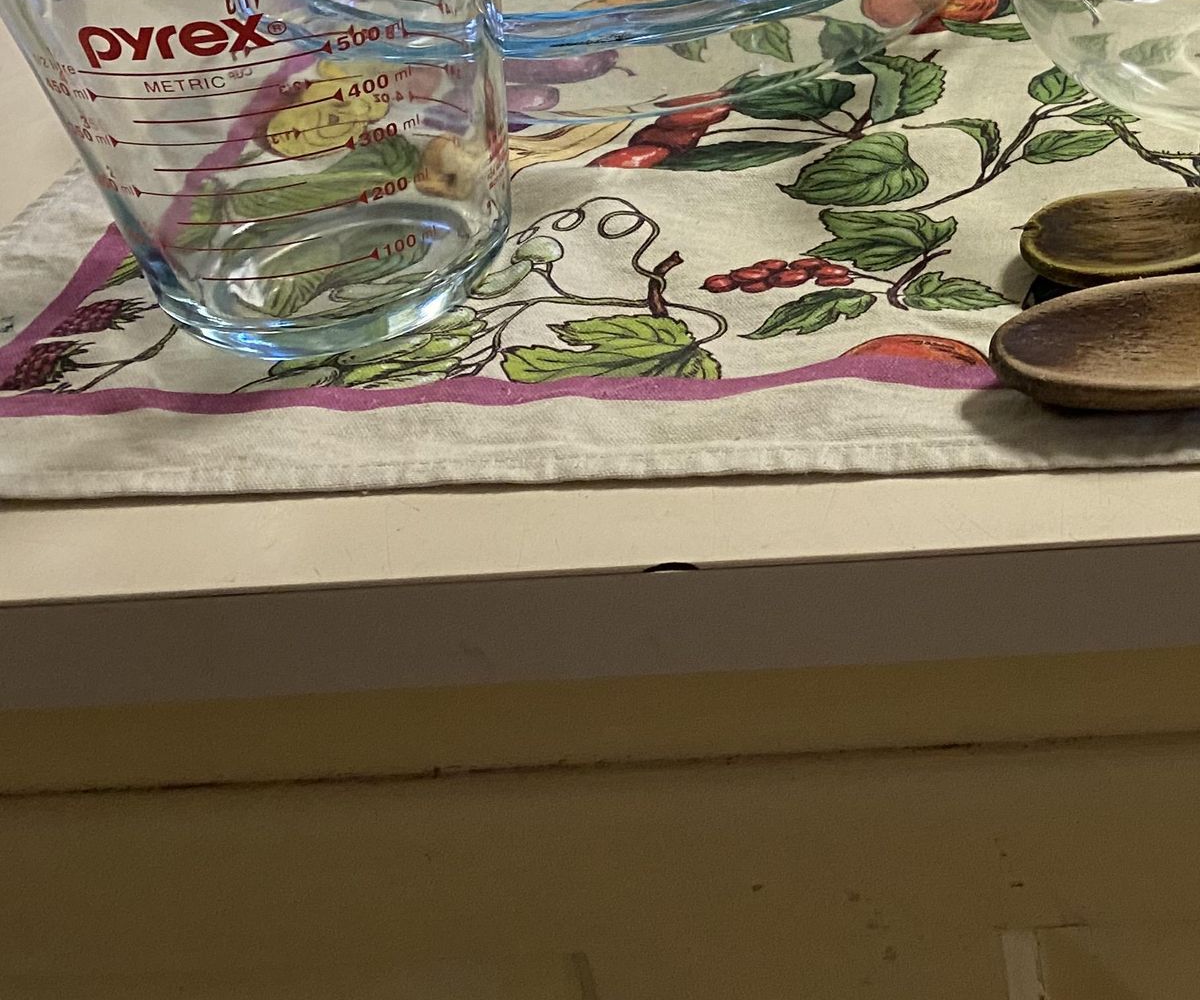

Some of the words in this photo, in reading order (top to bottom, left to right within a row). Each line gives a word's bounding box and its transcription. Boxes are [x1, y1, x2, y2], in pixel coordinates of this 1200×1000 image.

[78, 13, 275, 69] pyrex
[337, 25, 381, 51] 500
[143, 75, 226, 94] METRIC
[348, 73, 389, 98] 400
[394, 65, 412, 82] ml
[359, 122, 398, 147] 300
[403, 113, 420, 131] ml
[372, 176, 408, 201] 200
[383, 233, 417, 256] 100
